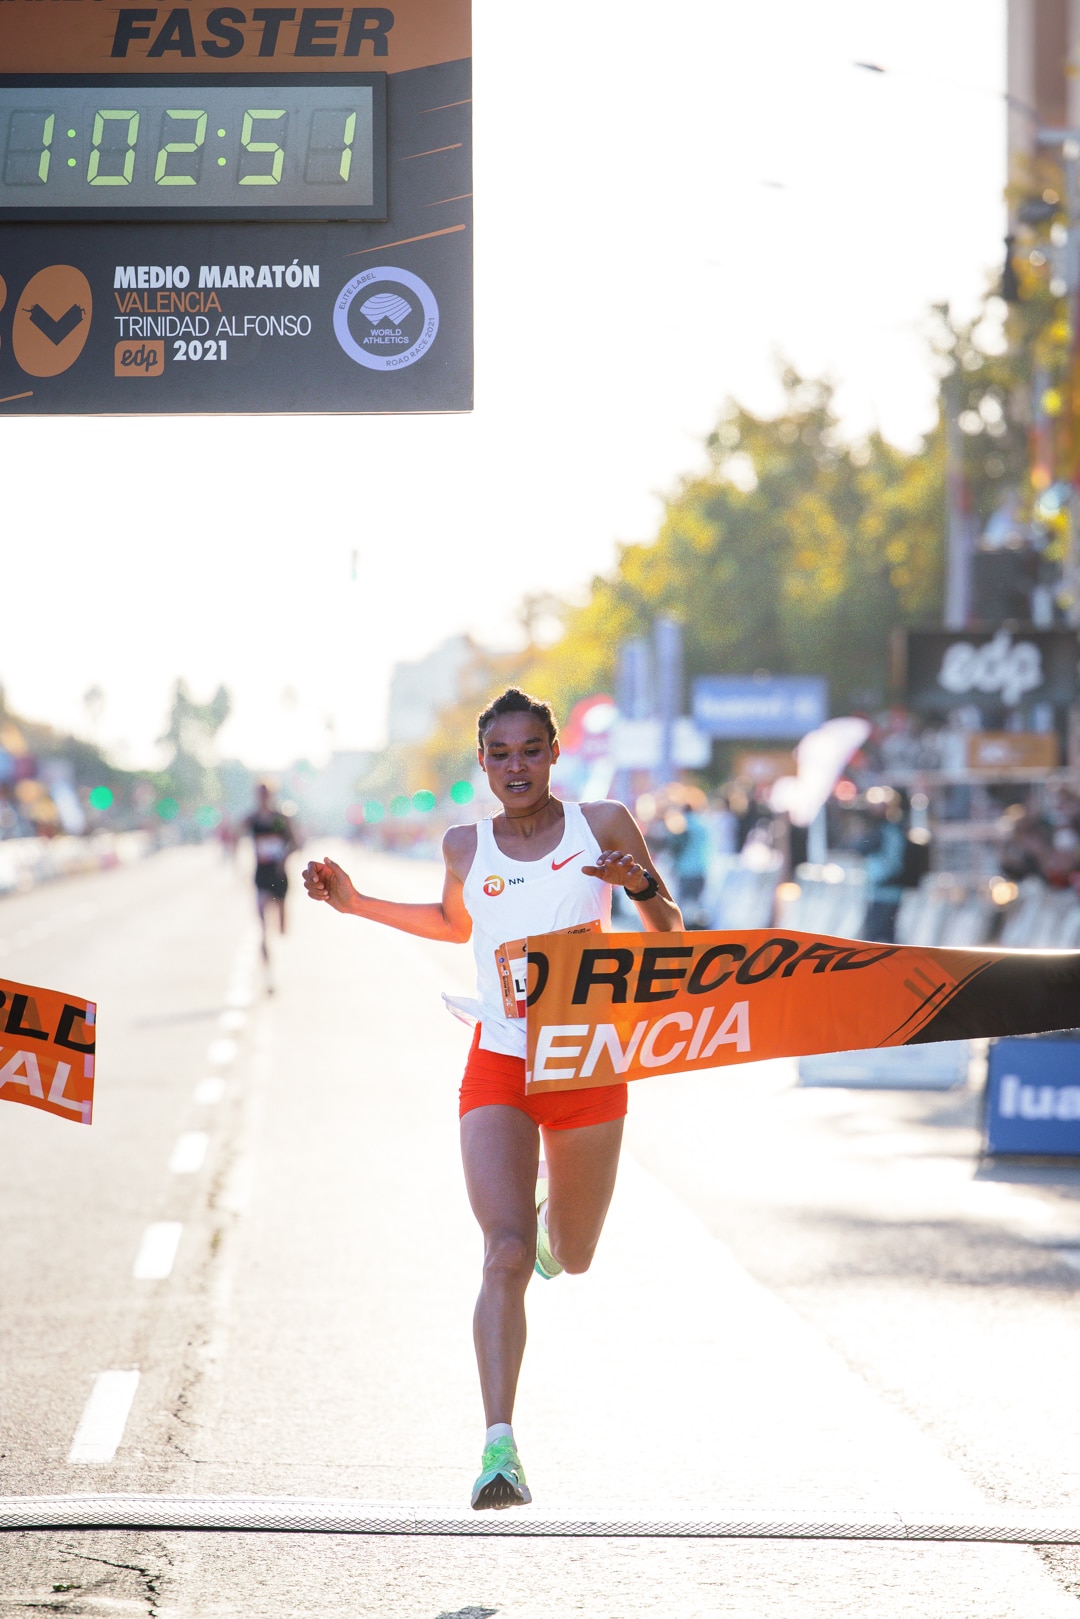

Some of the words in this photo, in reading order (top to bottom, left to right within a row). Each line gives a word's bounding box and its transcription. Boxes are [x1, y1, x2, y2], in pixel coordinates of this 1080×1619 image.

[110, 7, 395, 58] FASTER
[113, 265, 190, 289] MEDIO
[198, 258, 320, 288] MARATÓN
[339, 288, 354, 310] ELITE
[351, 272, 376, 290] LABEL
[114, 291, 222, 313] VALENCIA
[114, 316, 210, 337] TRINIDAD
[215, 315, 312, 337] ALFONSO
[363, 336, 410, 344] ATHLETICS
[370, 328, 402, 336] WORLD
[385, 356, 410, 367] ROAD
[409, 339, 429, 358] RACE
[425, 317, 435, 338] 2021
[120, 343, 158, 373] edp
[172, 340, 228, 361] 2021
[938, 631, 1043, 705] edp
[571, 937, 896, 1005] RECORD
[0, 989, 96, 1055] LD
[526, 1000, 751, 1084] ENCIA
[0, 1047, 92, 1114] AL
